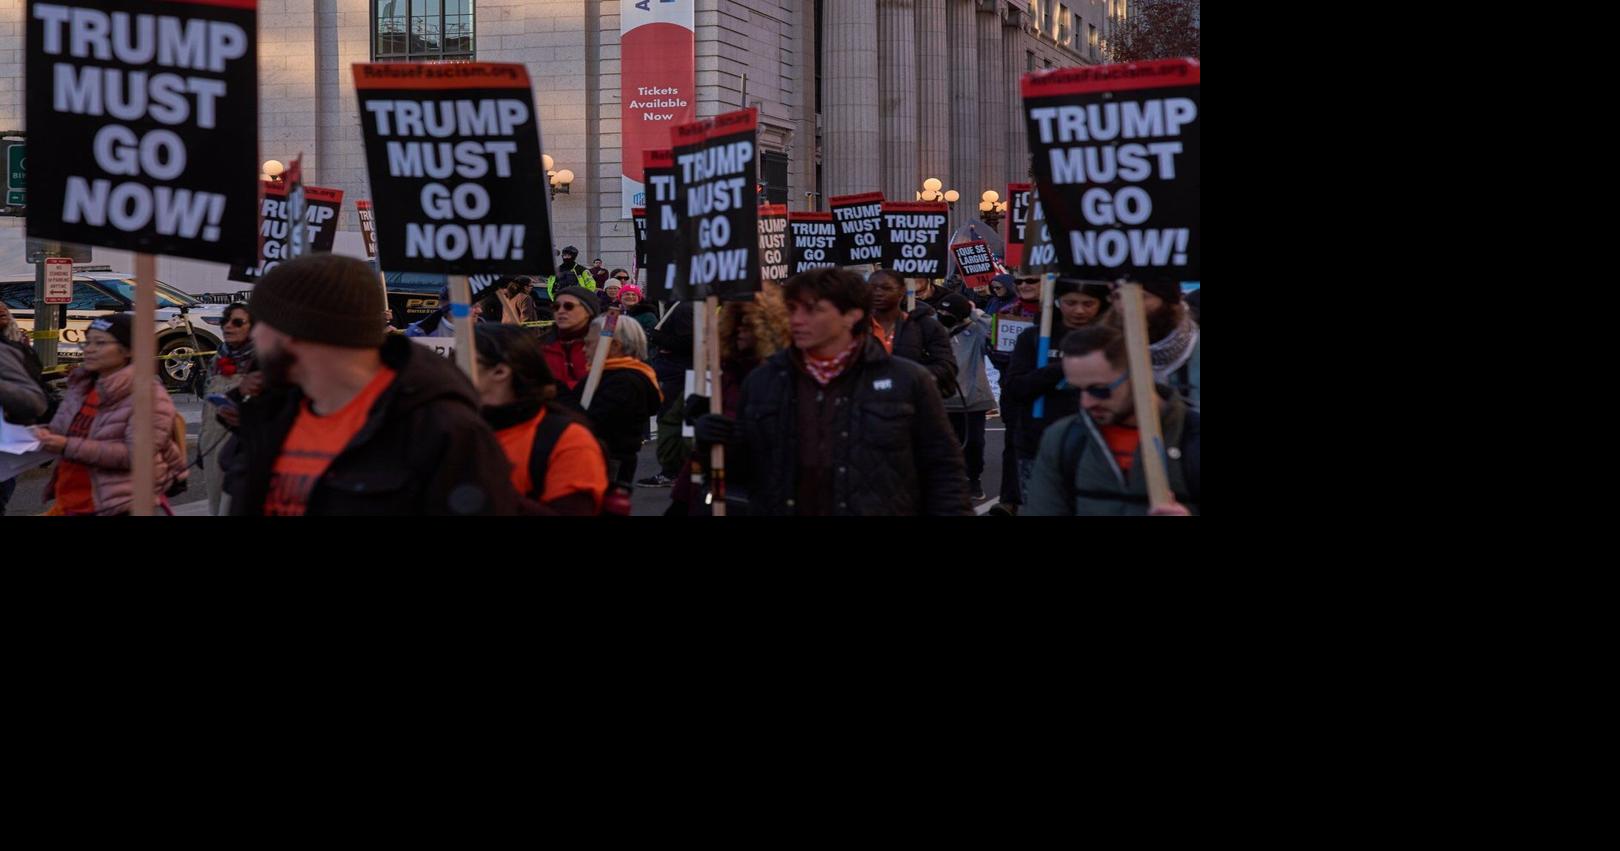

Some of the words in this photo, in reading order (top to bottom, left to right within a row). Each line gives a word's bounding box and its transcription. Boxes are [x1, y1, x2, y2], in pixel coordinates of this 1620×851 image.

[33, 2, 248, 73] TRUMP
[52, 62, 228, 129] MUST
[629, 98, 687, 109] Available
[638, 86, 678, 96] Tickets
[365, 98, 529, 138] TRUMP
[643, 112, 673, 121] Now
[1029, 97, 1198, 144] TRUMP
[92, 123, 188, 181] GO
[385, 140, 518, 180] MUST
[677, 141, 754, 184] TRUMP
[1048, 140, 1183, 184] MUST
[62, 175, 227, 242] NOW!
[420, 181, 491, 221] GO
[687, 177, 746, 217] MUST
[1081, 185, 1152, 226] GO
[699, 214, 731, 249] GO
[842, 218, 881, 234] MUST
[884, 214, 945, 229] TRUMP
[405, 222, 526, 261] NOW!
[795, 236, 836, 249] MUST
[854, 233, 875, 246] GO
[890, 230, 940, 243] MUST
[974, 244, 986, 254] SE
[1069, 227, 1190, 268] NOW!
[765, 249, 781, 264] GO
[804, 249, 825, 261] GO
[901, 244, 927, 258] GO
[958, 253, 990, 266] LARGUE
[688, 248, 749, 286] NOW!
[761, 264, 788, 280] NOW!
[892, 259, 938, 273] NOW!
[963, 262, 991, 274] TRUMP
